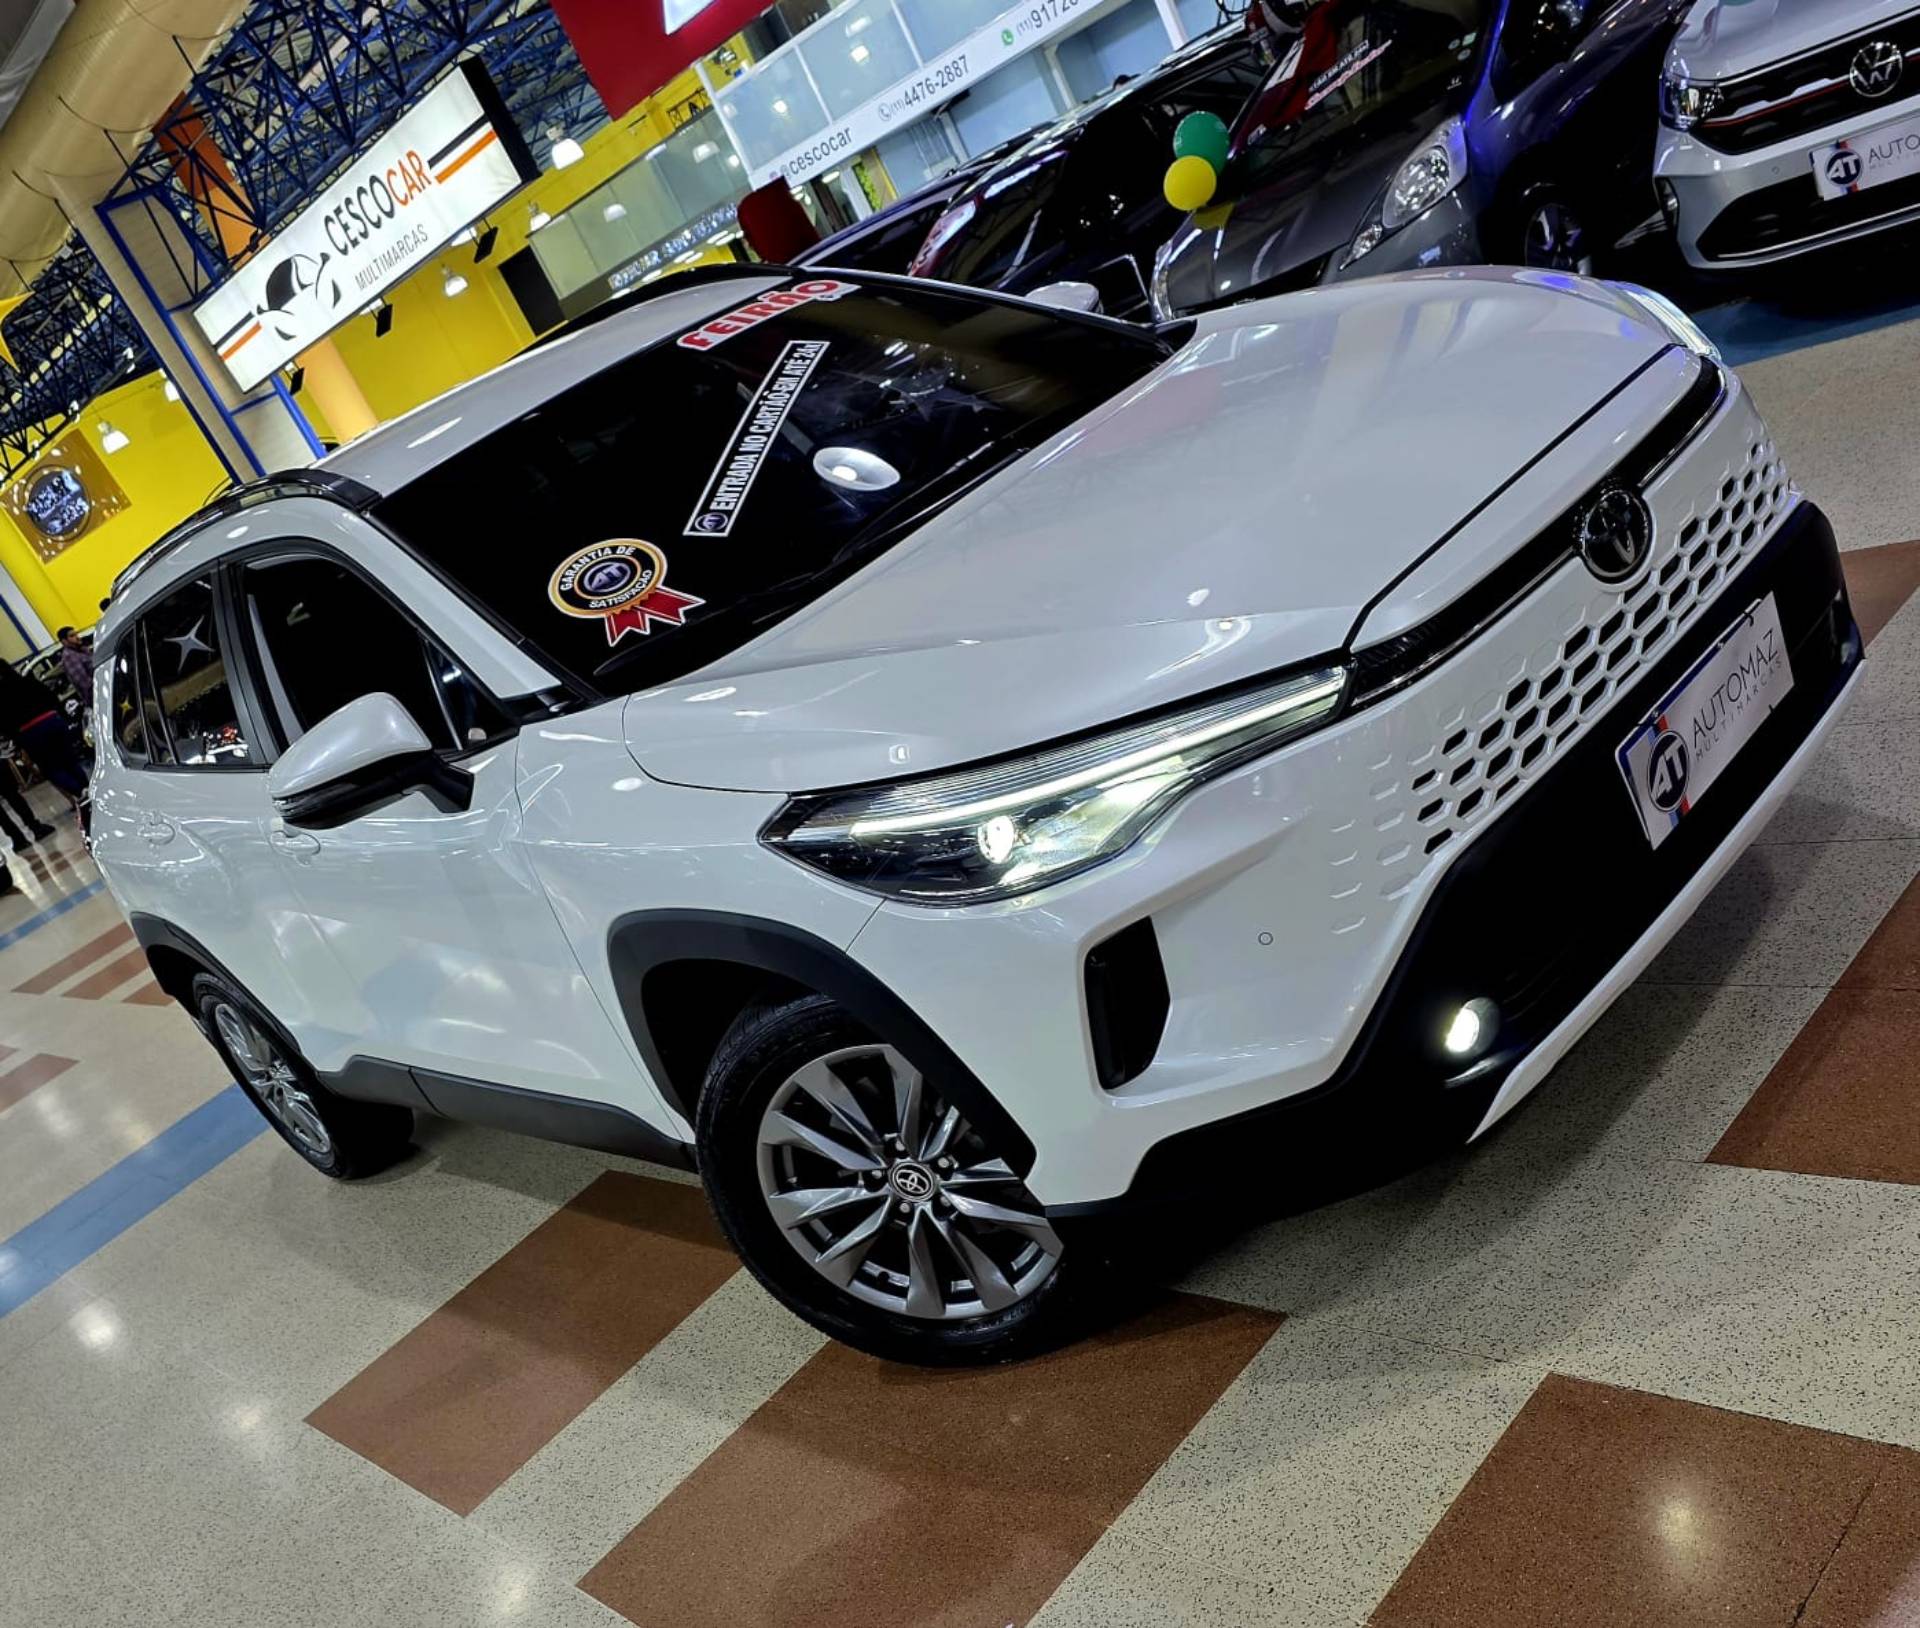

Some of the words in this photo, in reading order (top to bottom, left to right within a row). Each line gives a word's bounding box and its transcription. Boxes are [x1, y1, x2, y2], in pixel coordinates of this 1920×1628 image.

[324, 150, 432, 256] CESCOCAR
[354, 223, 429, 291] MULTIMARCAS
[709, 453, 759, 511] ENTRADA
[738, 434, 769, 452] NO
[781, 359, 811, 377] ATÉ
[560, 546, 612, 591] GARANTIA
[616, 545, 637, 556] DE
[1693, 628, 1778, 749] AUTOMAZ
[1695, 656, 1782, 761] MULTIMARCAS
